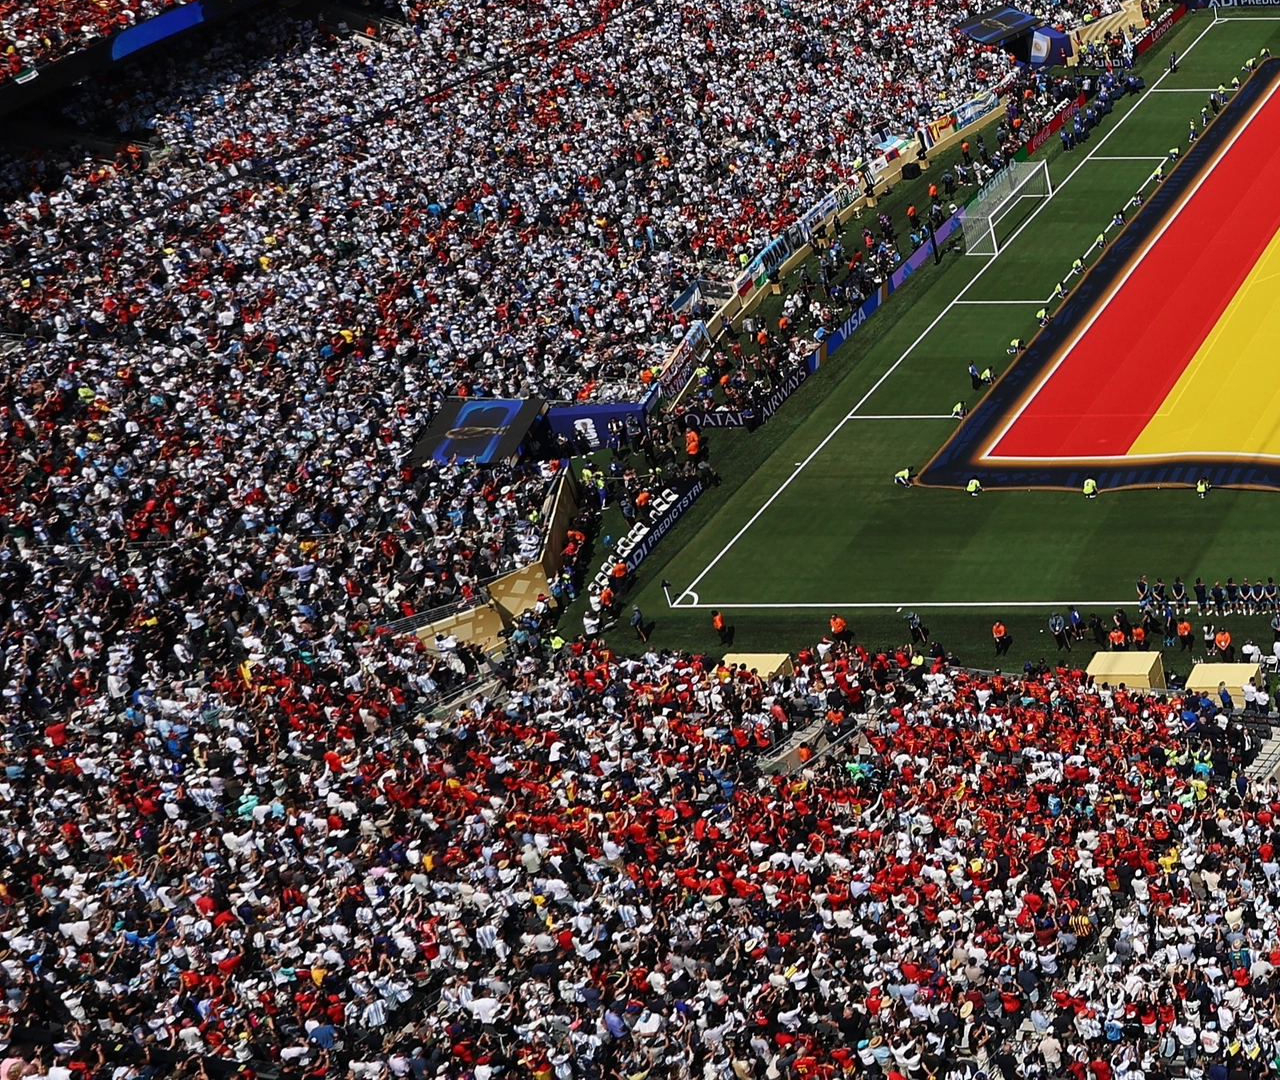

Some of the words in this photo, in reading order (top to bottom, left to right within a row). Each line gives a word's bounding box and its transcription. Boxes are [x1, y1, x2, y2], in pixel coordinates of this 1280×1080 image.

[1151, 18, 1173, 41] Lenovo
[837, 307, 866, 340] VISA
[762, 366, 807, 422] AIRWAYS
